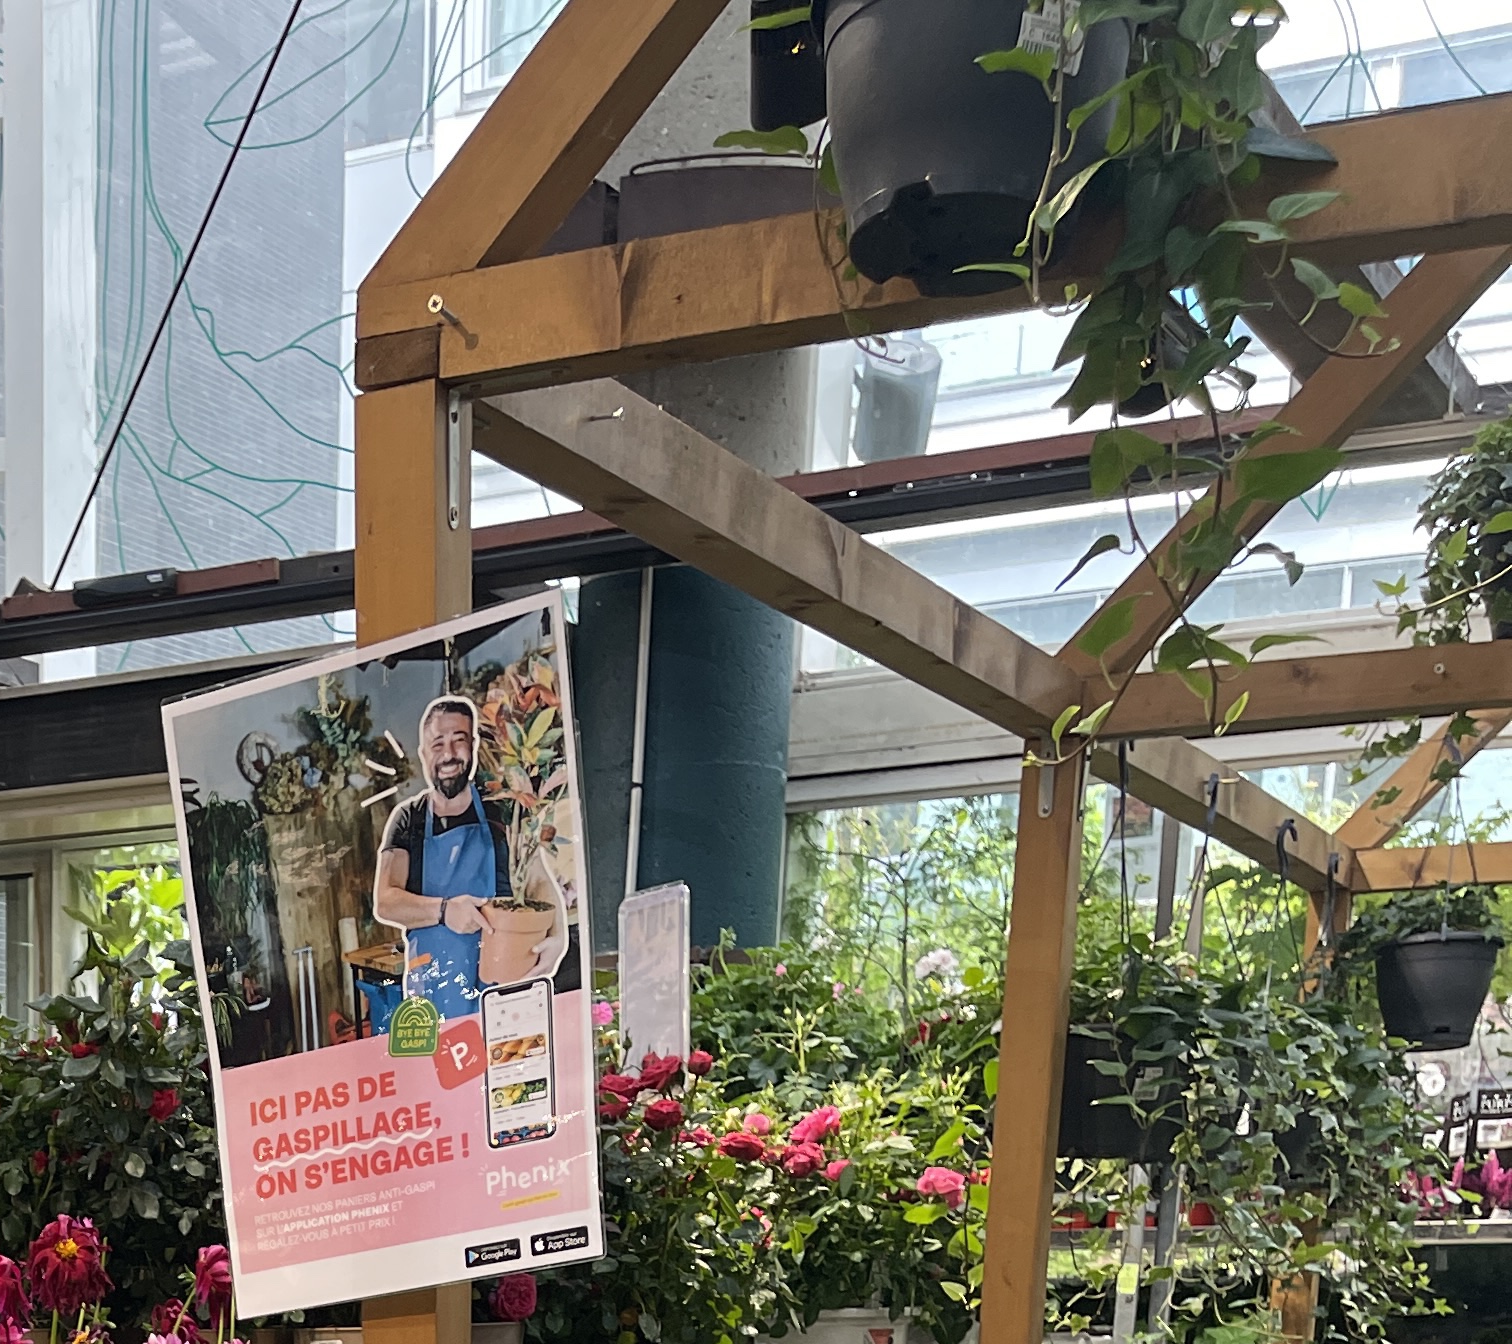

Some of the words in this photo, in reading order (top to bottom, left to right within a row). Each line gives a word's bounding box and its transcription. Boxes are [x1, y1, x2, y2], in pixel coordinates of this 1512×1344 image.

[250, 1095, 287, 1127] ICI
[294, 1082, 350, 1117] PAS
[357, 1071, 397, 1103] DE
[252, 1101, 442, 1163] GASPILLAGE,
[255, 1168, 298, 1200] ON
[461, 1132, 470, 1159] !
[254, 1204, 310, 1226] RETROUVEZ
[311, 1200, 334, 1215] NOS
[335, 1192, 377, 1210] PANIERS
[378, 1180, 436, 1201] ANTI-GASPI
[256, 1225, 277, 1239] SUR
[351, 1203, 390, 1220] PHENIX
[391, 1200, 403, 1213] ET
[480, 1250, 504, 1261] Google
[548, 1240, 564, 1250] App
[564, 1235, 586, 1246] Store
